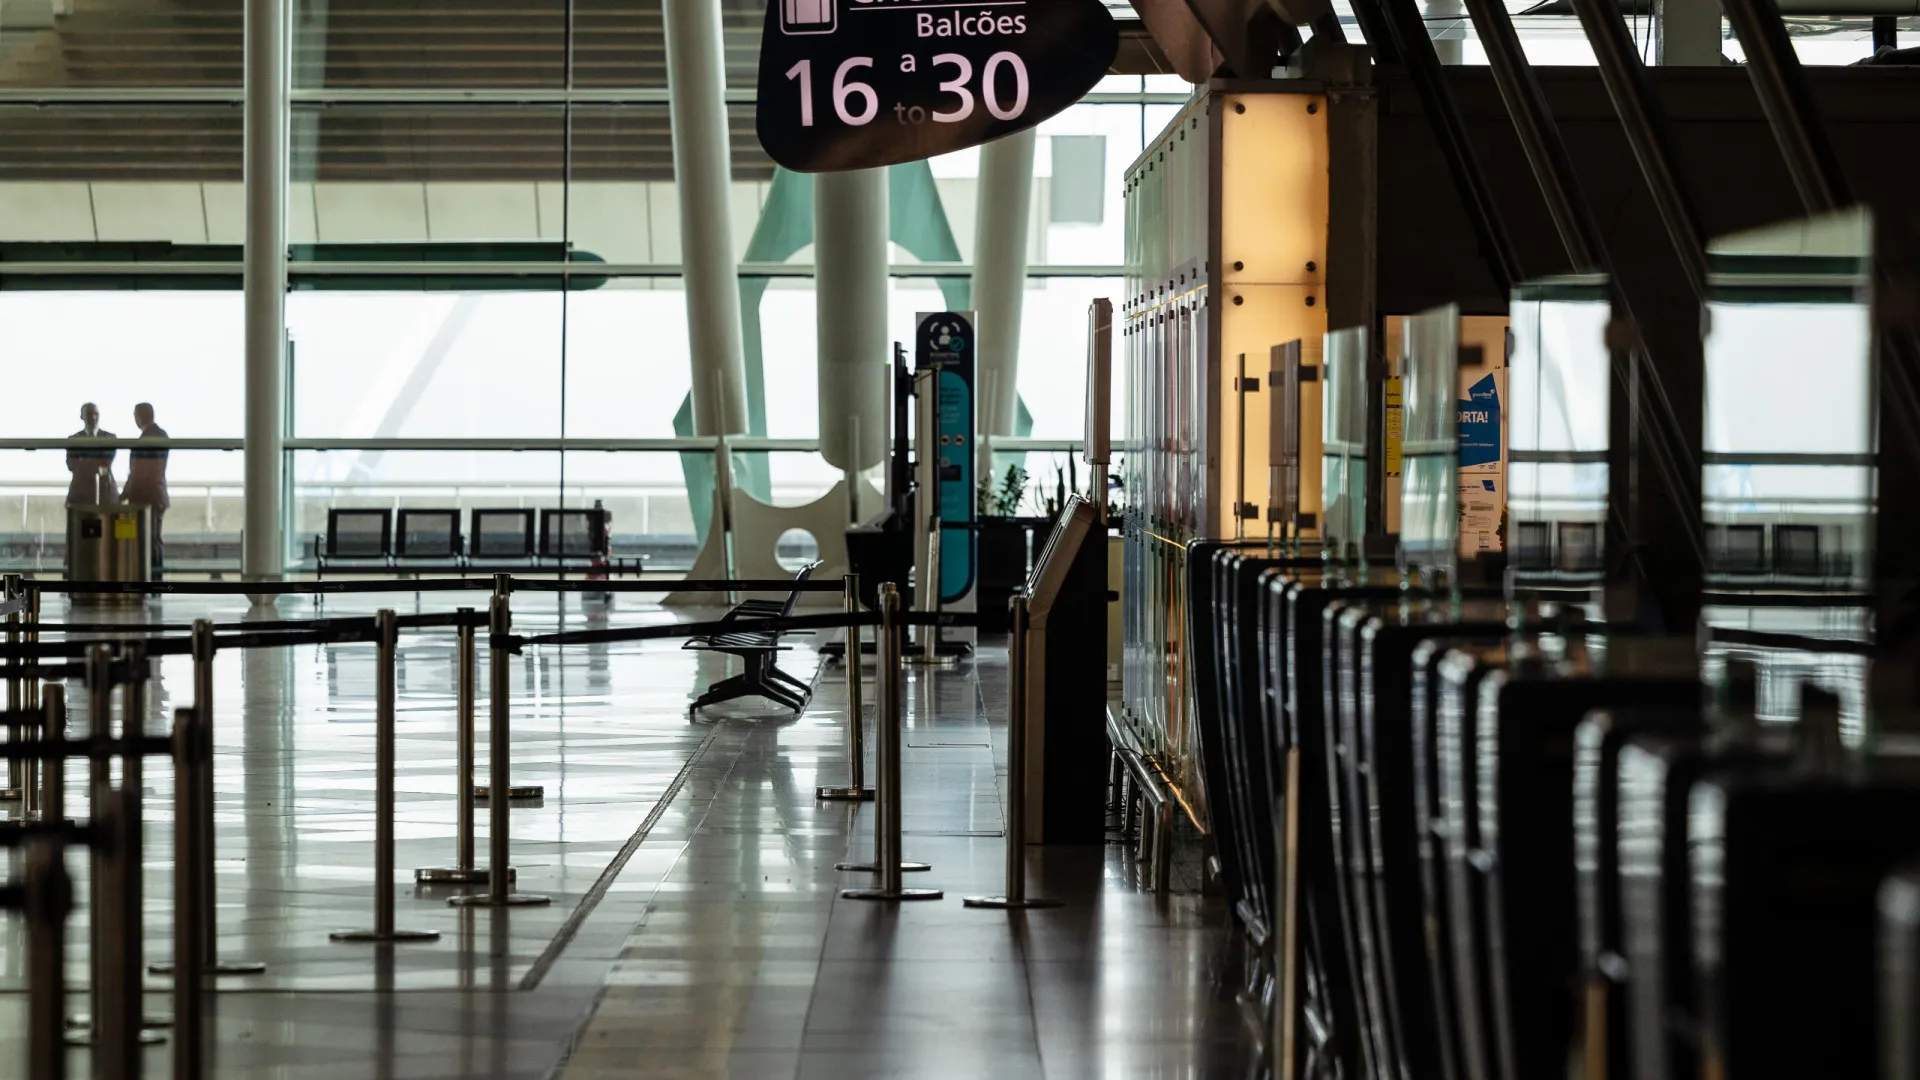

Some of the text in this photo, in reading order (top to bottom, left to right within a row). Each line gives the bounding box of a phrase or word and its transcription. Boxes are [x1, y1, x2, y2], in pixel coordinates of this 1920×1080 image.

[916, 10, 1027, 37] Balcões
[785, 50, 1030, 127] 16 a 30
[893, 102, 926, 125] to
